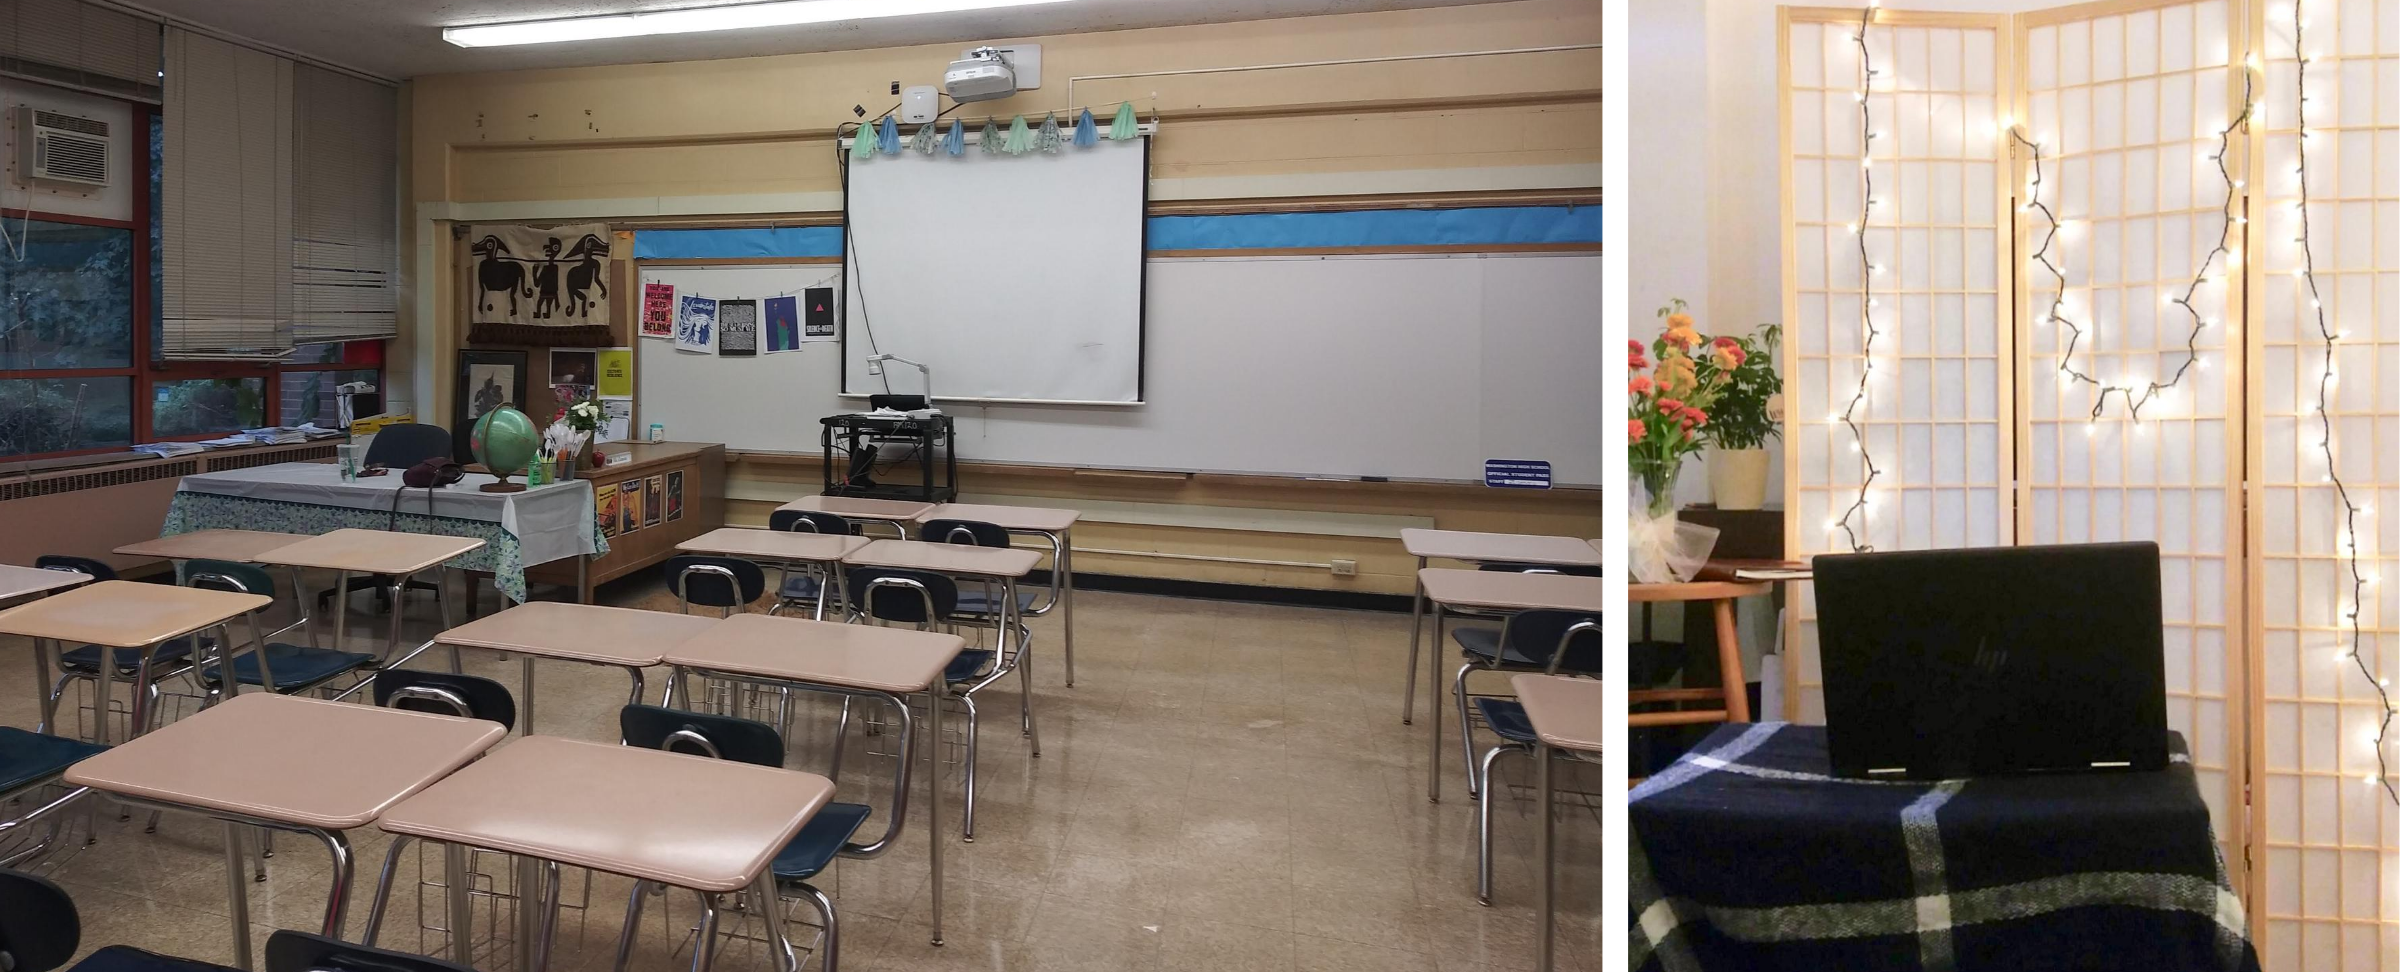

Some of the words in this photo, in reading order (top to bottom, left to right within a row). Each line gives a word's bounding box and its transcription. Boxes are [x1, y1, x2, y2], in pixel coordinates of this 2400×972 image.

[645, 292, 673, 300] WELCOME
[650, 311, 667, 322] YOU
[643, 322, 672, 334] BELONG
